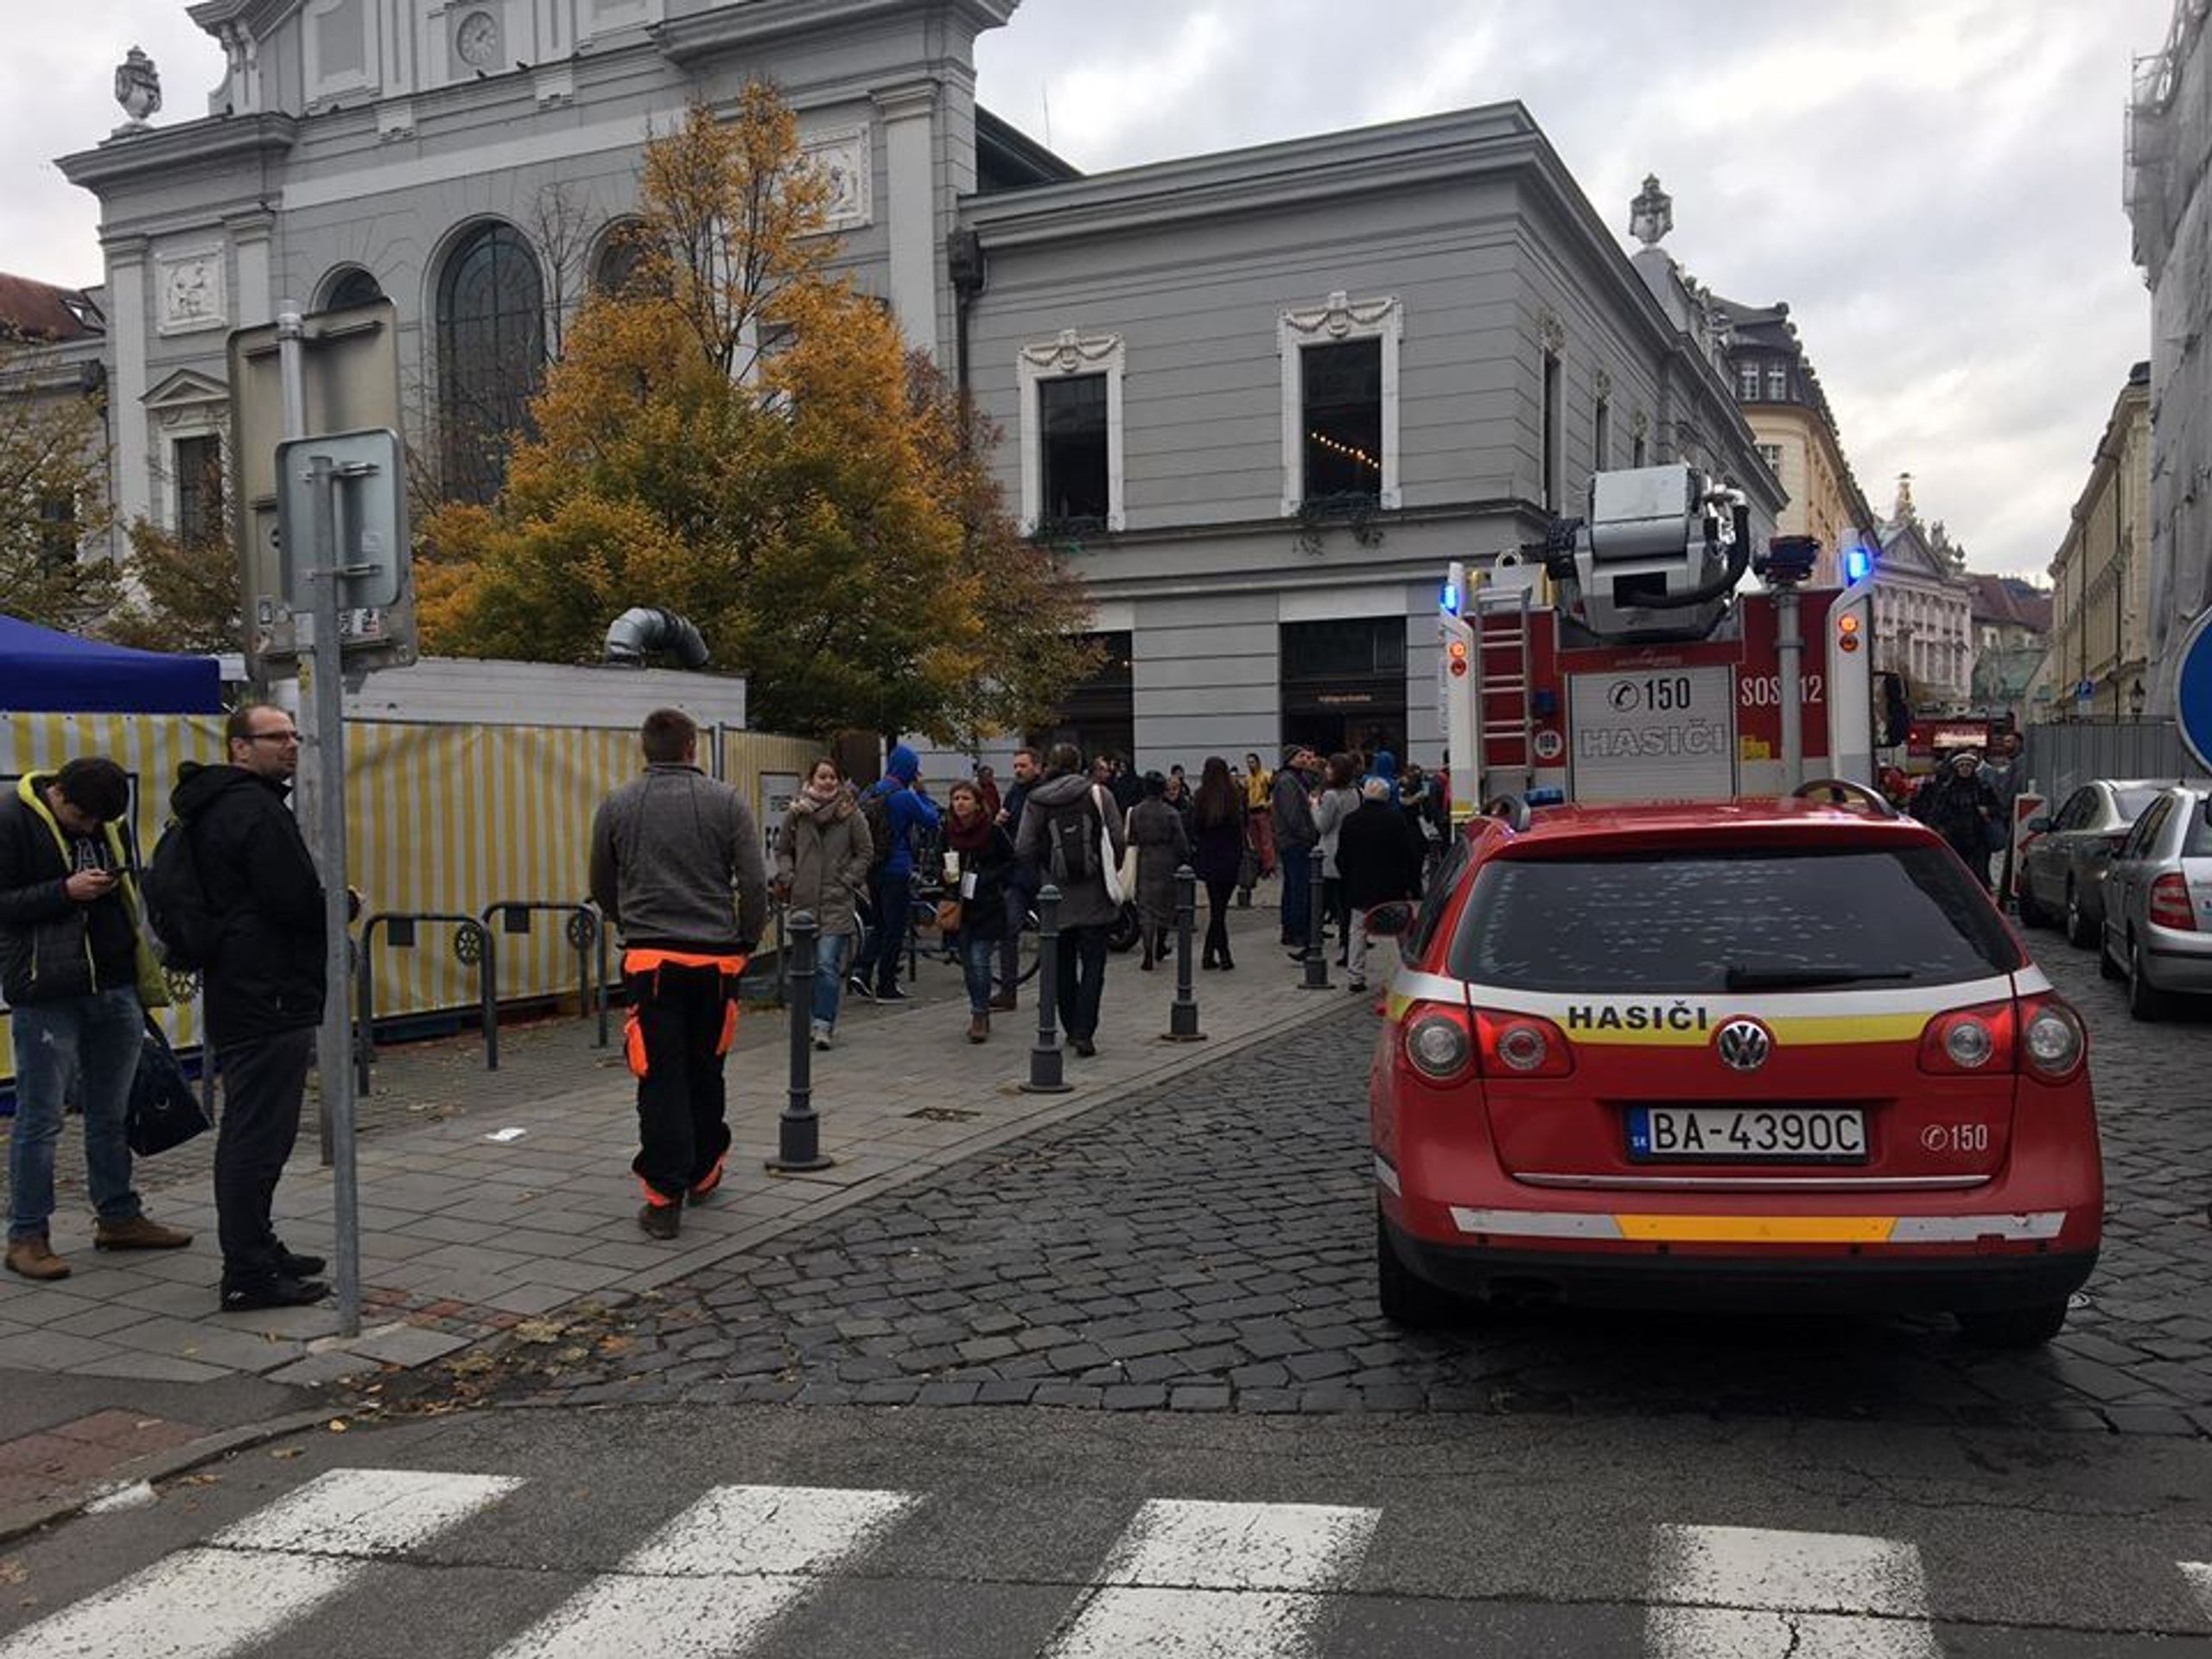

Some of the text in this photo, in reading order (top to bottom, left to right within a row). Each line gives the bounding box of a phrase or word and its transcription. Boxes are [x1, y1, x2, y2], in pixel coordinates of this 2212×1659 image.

[1645, 677, 1690, 710] 150
[1742, 675, 1822, 706] SOS 12
[1581, 719, 1726, 759] HASIČI
[1568, 1000, 1707, 1031] HASIČI
[1951, 1124, 1987, 1150] 150
